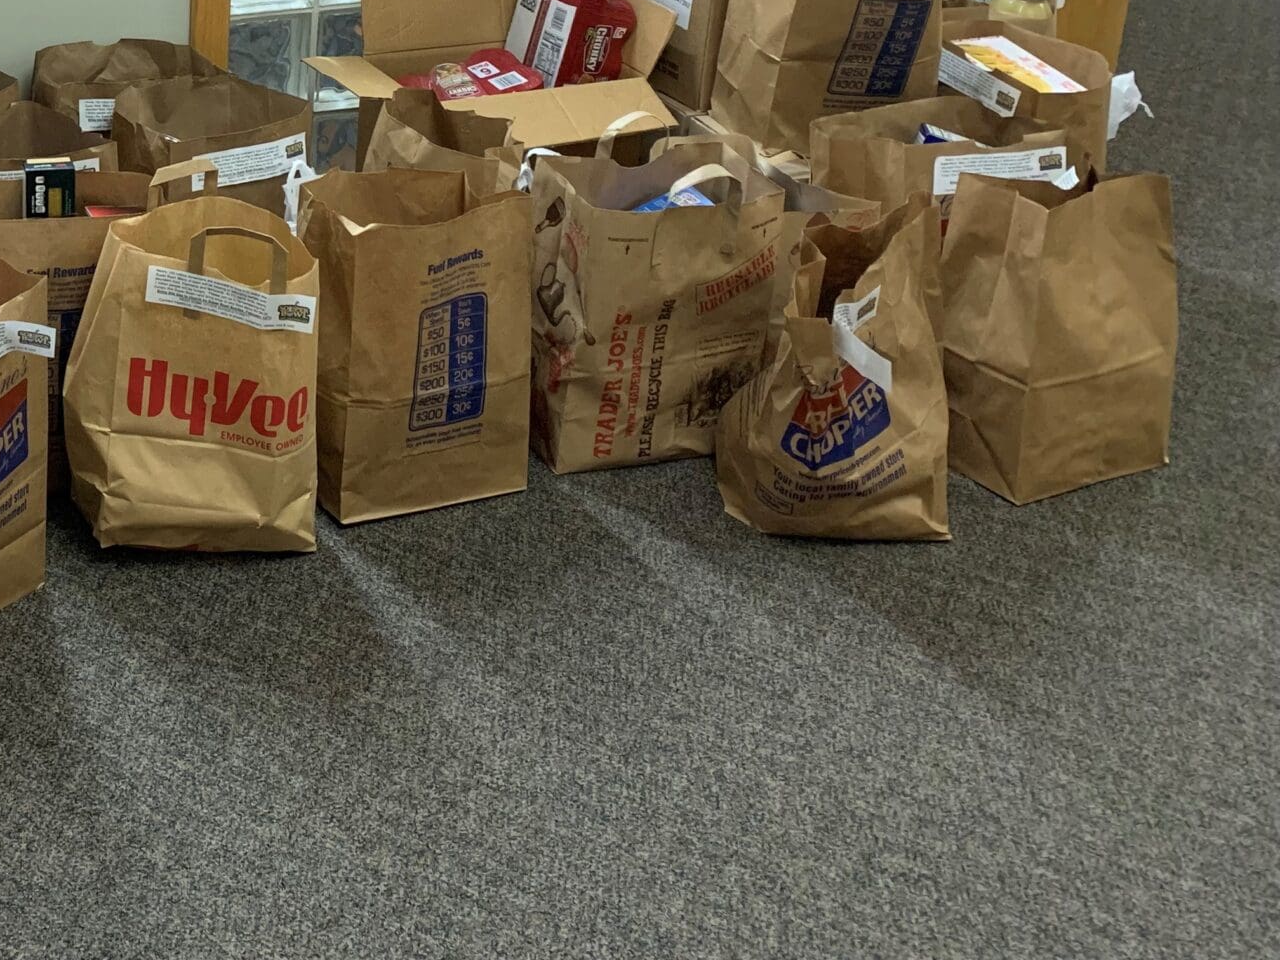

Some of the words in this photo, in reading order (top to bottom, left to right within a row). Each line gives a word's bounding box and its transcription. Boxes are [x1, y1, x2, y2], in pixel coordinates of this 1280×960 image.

[586, 27, 608, 71] CHUNKY
[427, 260, 448, 276] Fuel
[447, 248, 484, 270] Rewards
[659, 298, 676, 321] BAG
[427, 326, 445, 341] $50
[457, 317, 472, 330] 5¢
[652, 321, 668, 354] THIS
[423, 342, 446, 358] $100
[455, 334, 474, 348] 10¢
[607, 313, 633, 372] JOE'S
[421, 359, 446, 375] $150
[455, 352, 474, 366] 15¢
[419, 376, 445, 392] $200
[453, 368, 474, 382] 20¢
[647, 355, 664, 412] RECYCLE
[126, 357, 308, 437] HyVee
[415, 408, 443, 423] $300
[451, 401, 472, 415] 30¢
[593, 377, 624, 459] TRADER
[220, 430, 272, 451] EMPLOYEE
[275, 434, 304, 451] OWNED
[638, 410, 656, 458] PLEASE
[773, 465, 794, 488] Your
[825, 479, 859, 495] family
[884, 447, 906, 471] store
[13, 482, 30, 504] store
[808, 489, 824, 501] for
